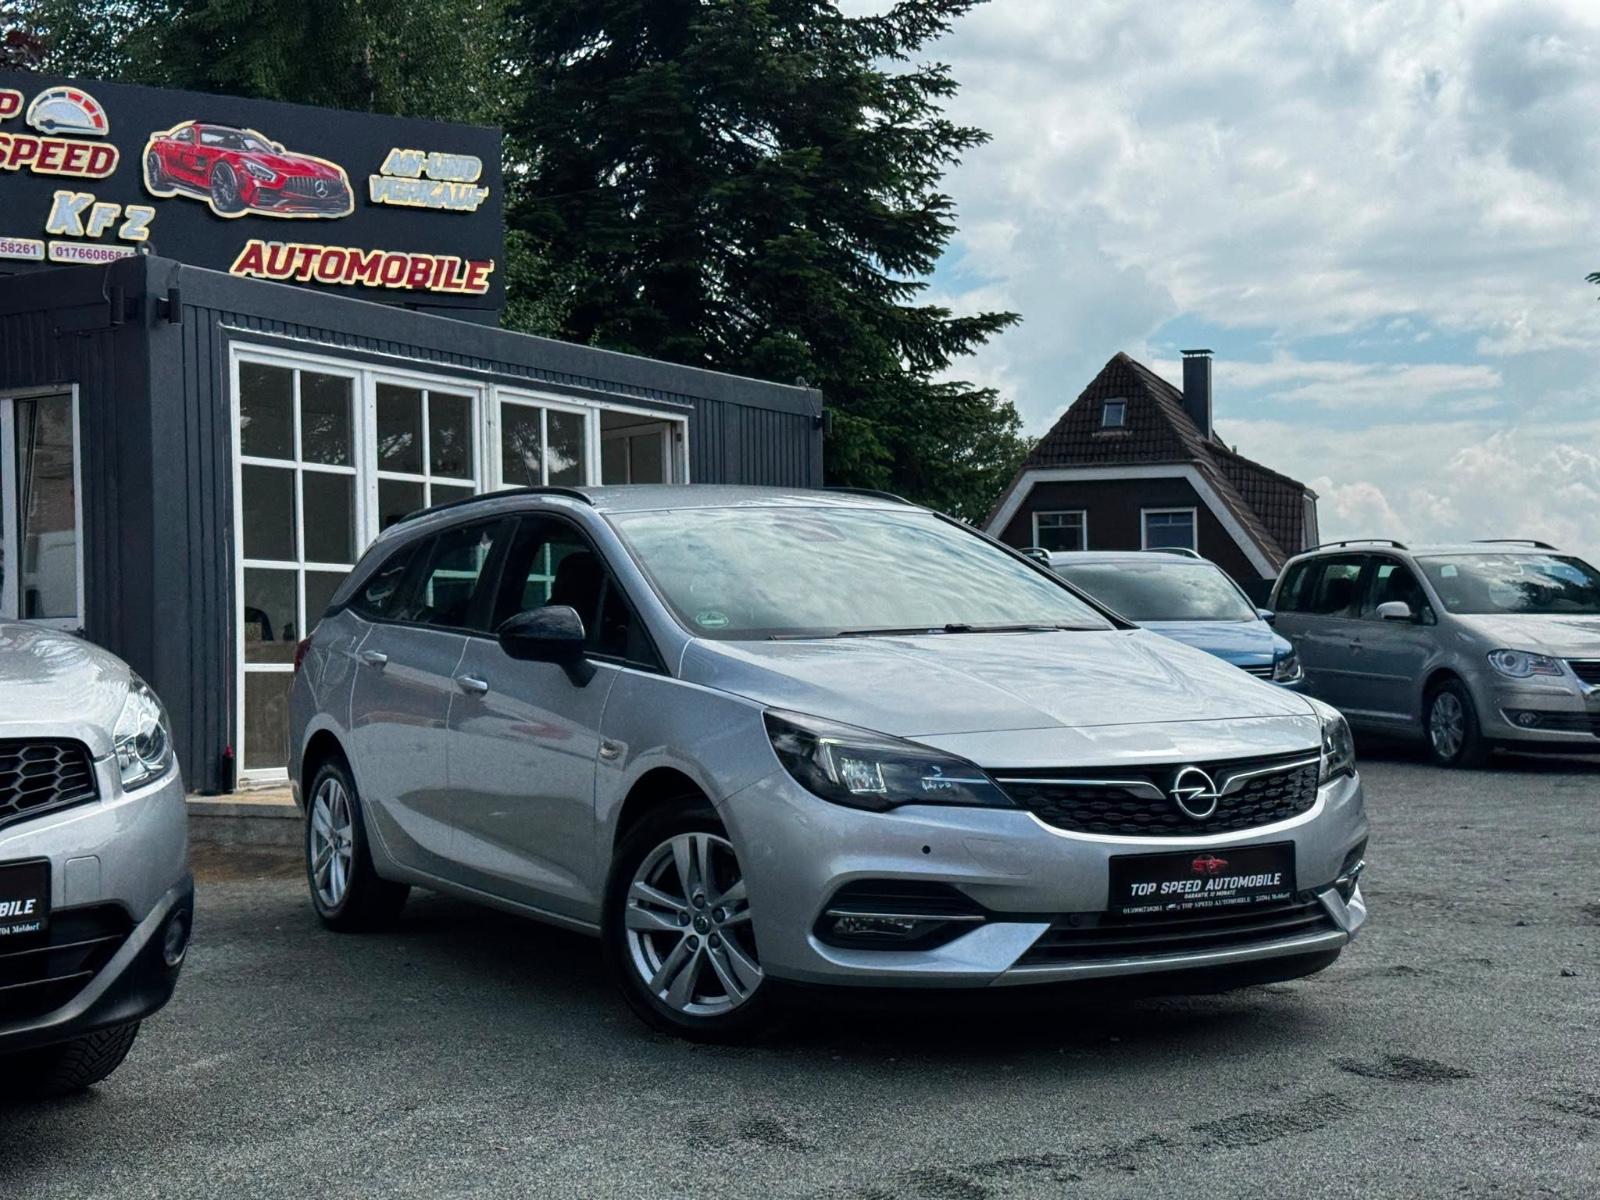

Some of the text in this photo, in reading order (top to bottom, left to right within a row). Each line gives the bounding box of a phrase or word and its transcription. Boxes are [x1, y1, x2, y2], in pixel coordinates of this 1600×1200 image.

[231, 242, 493, 292] AUTOMOBILE
[1131, 873, 1282, 896] TOP SPEED AUTOMOBILE
